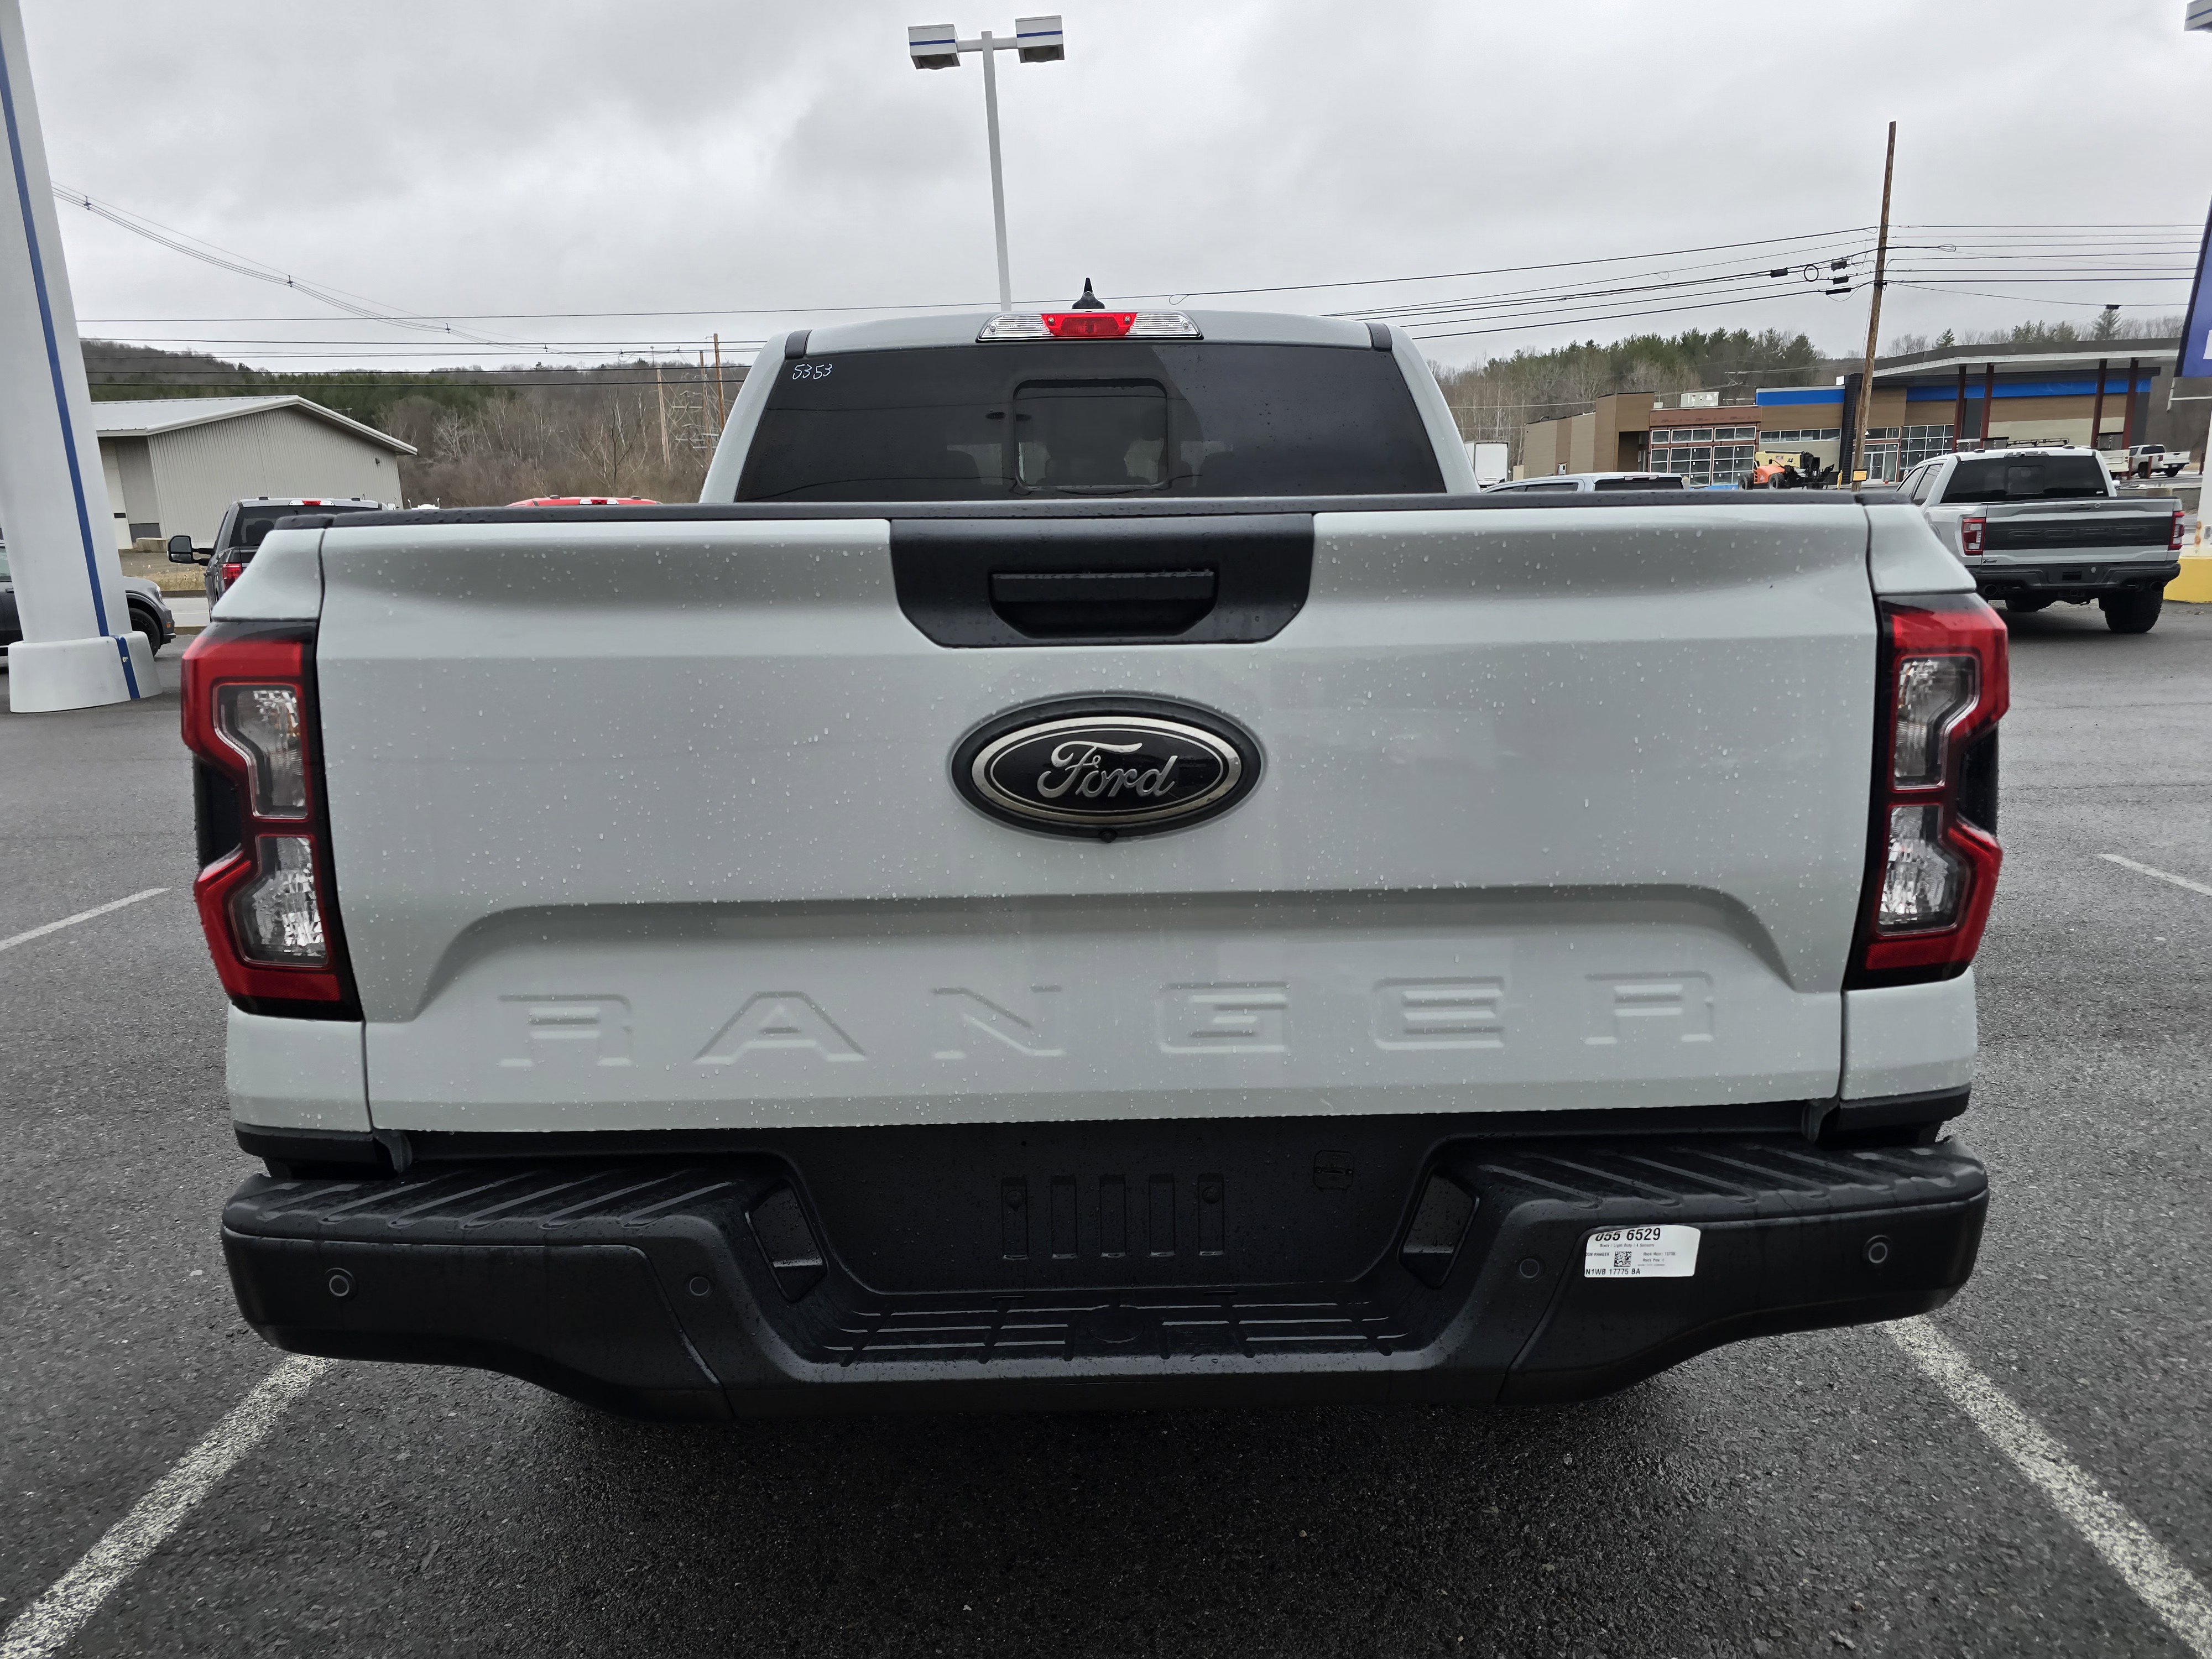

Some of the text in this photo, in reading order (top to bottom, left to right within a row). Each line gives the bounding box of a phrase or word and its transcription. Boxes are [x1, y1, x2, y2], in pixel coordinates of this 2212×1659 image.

[792, 363, 833, 380] 5353
[1037, 740, 1178, 799] Ford
[498, 971, 1714, 1067] RANGER
[1626, 1227, 1661, 1241] 6529
